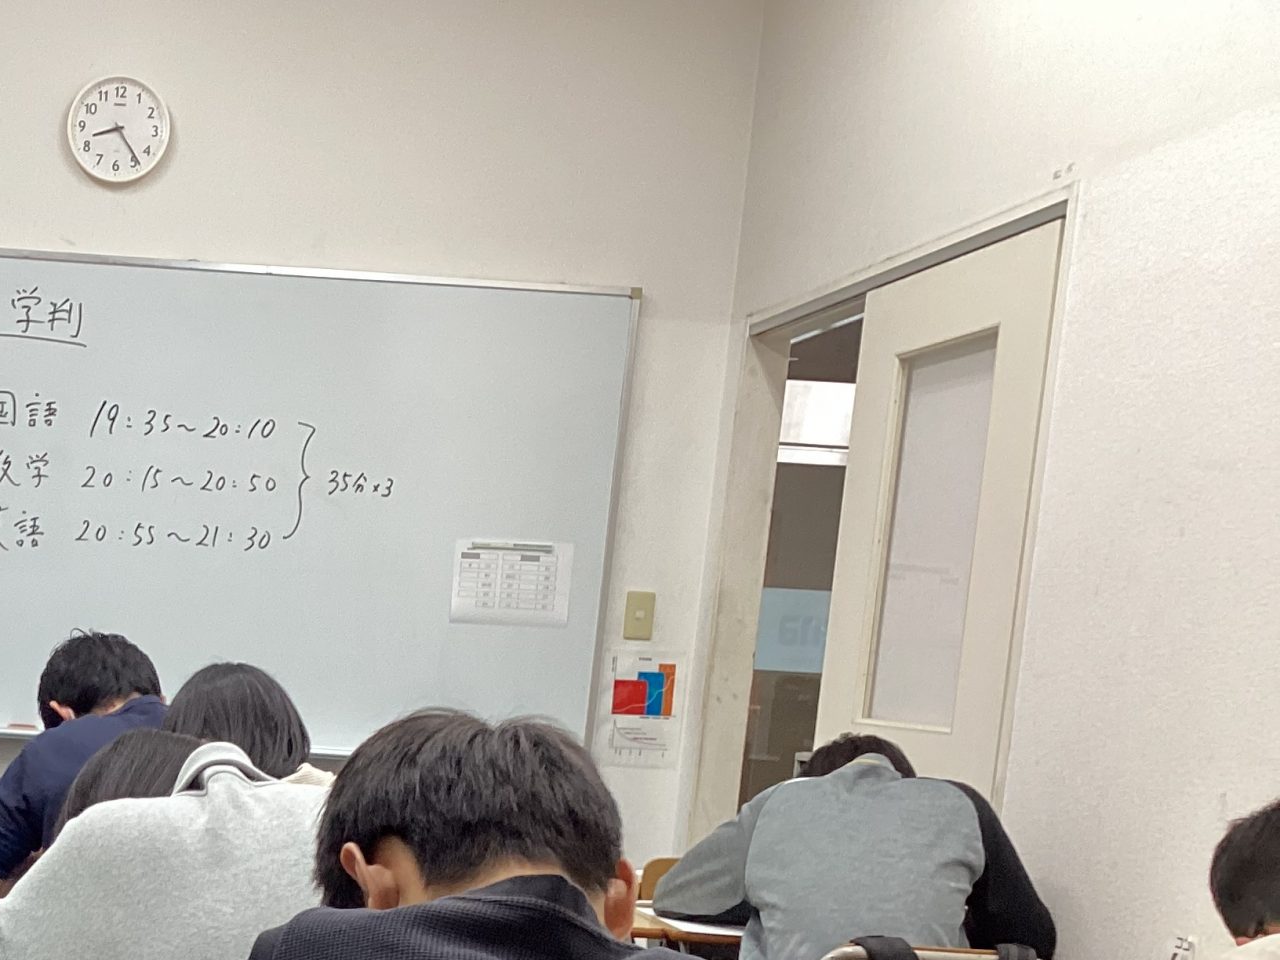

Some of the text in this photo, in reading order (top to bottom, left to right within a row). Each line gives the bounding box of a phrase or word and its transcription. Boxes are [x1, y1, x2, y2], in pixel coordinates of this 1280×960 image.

[98, 90, 108, 101] 11
[115, 86, 127, 98] 12
[137, 92, 142, 104] 1
[84, 103, 97, 115] 10
[147, 107, 155, 119] 2
[79, 120, 86, 132] 9
[151, 125, 159, 137] 3
[83, 140, 91, 152] 8
[143, 145, 151, 156] 4
[96, 153, 104, 165] 7
[112, 160, 120, 171] 6
[12, 286, 83, 338] 学判
